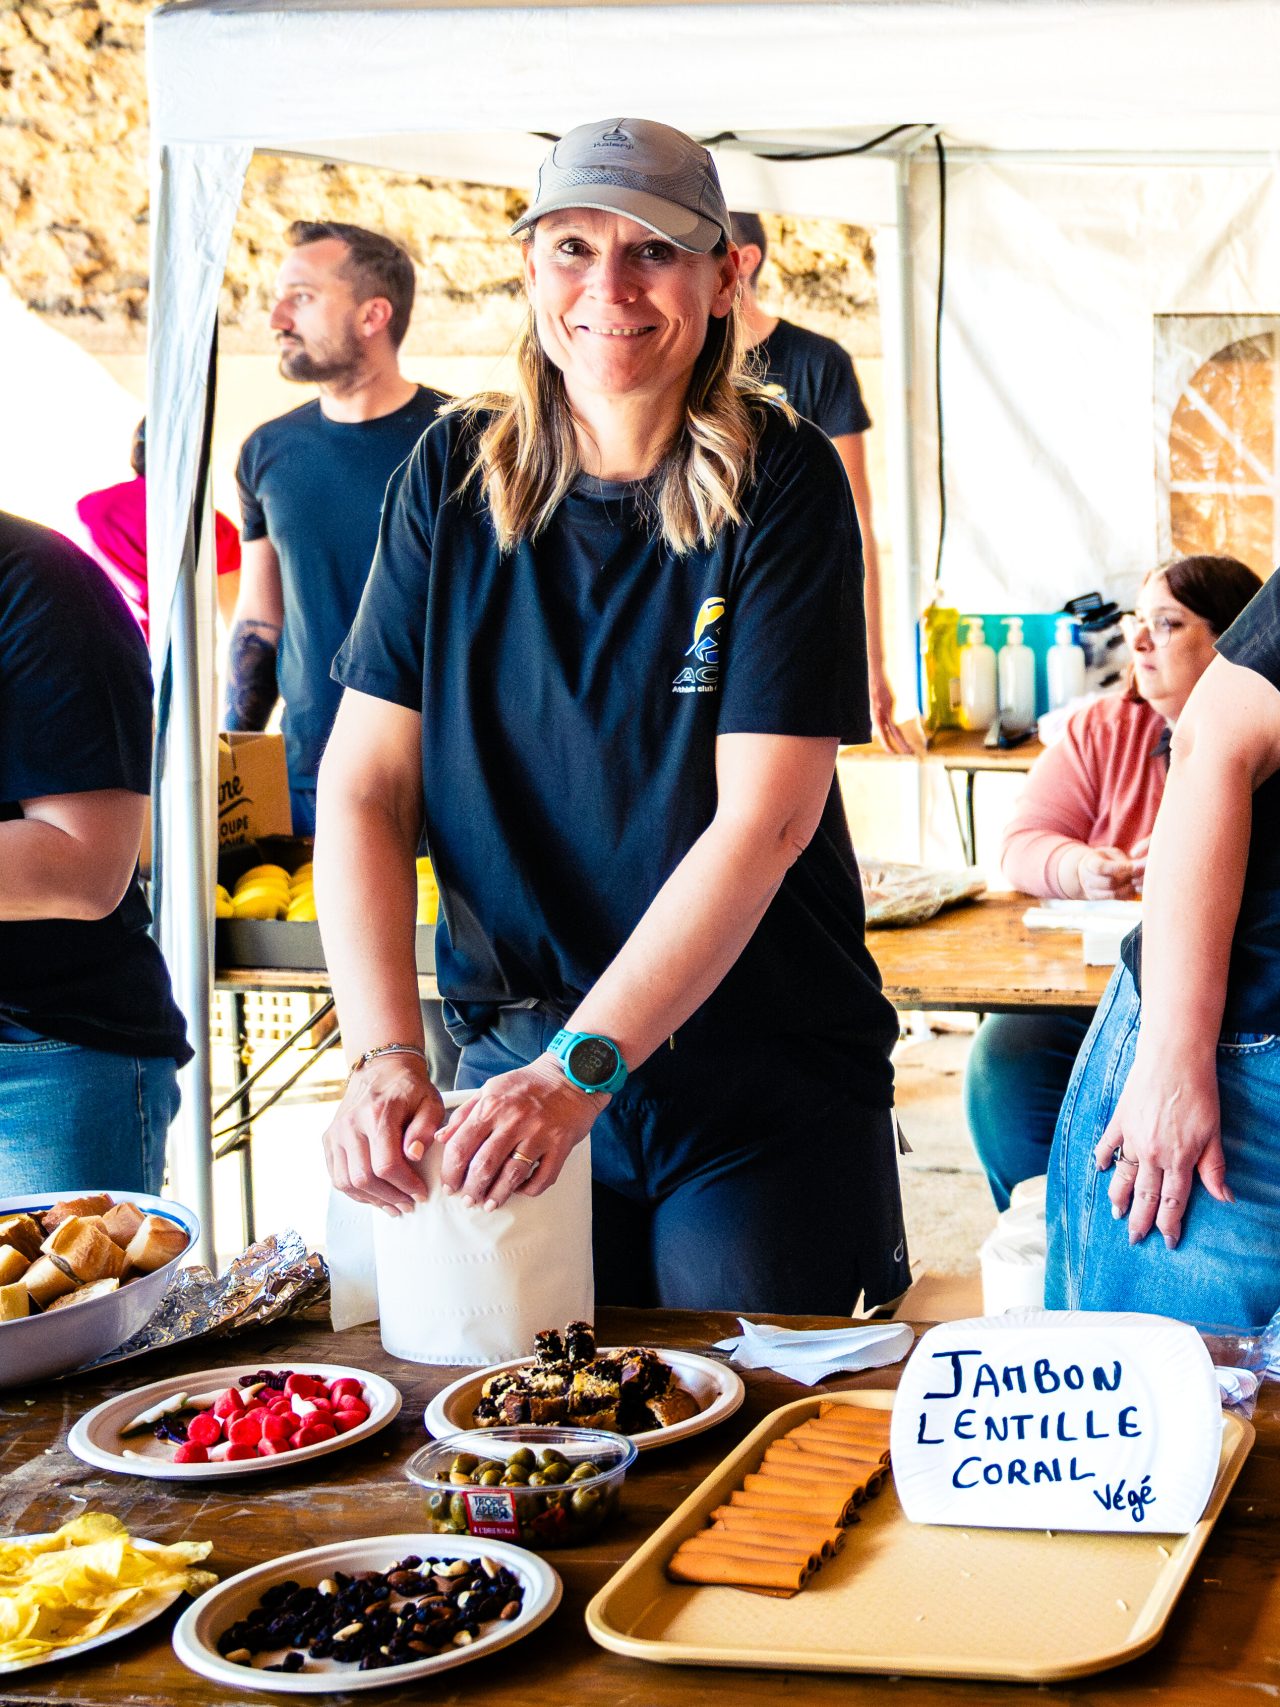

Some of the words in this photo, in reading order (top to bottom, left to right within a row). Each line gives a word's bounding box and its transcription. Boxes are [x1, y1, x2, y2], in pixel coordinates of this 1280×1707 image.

[672, 666, 719, 683] AC
[220, 815, 249, 836] OUPE
[923, 1350, 1122, 1399] JAMBON
[917, 1406, 1142, 1444] LENTILLE
[952, 1456, 1095, 1488] CORAIL
